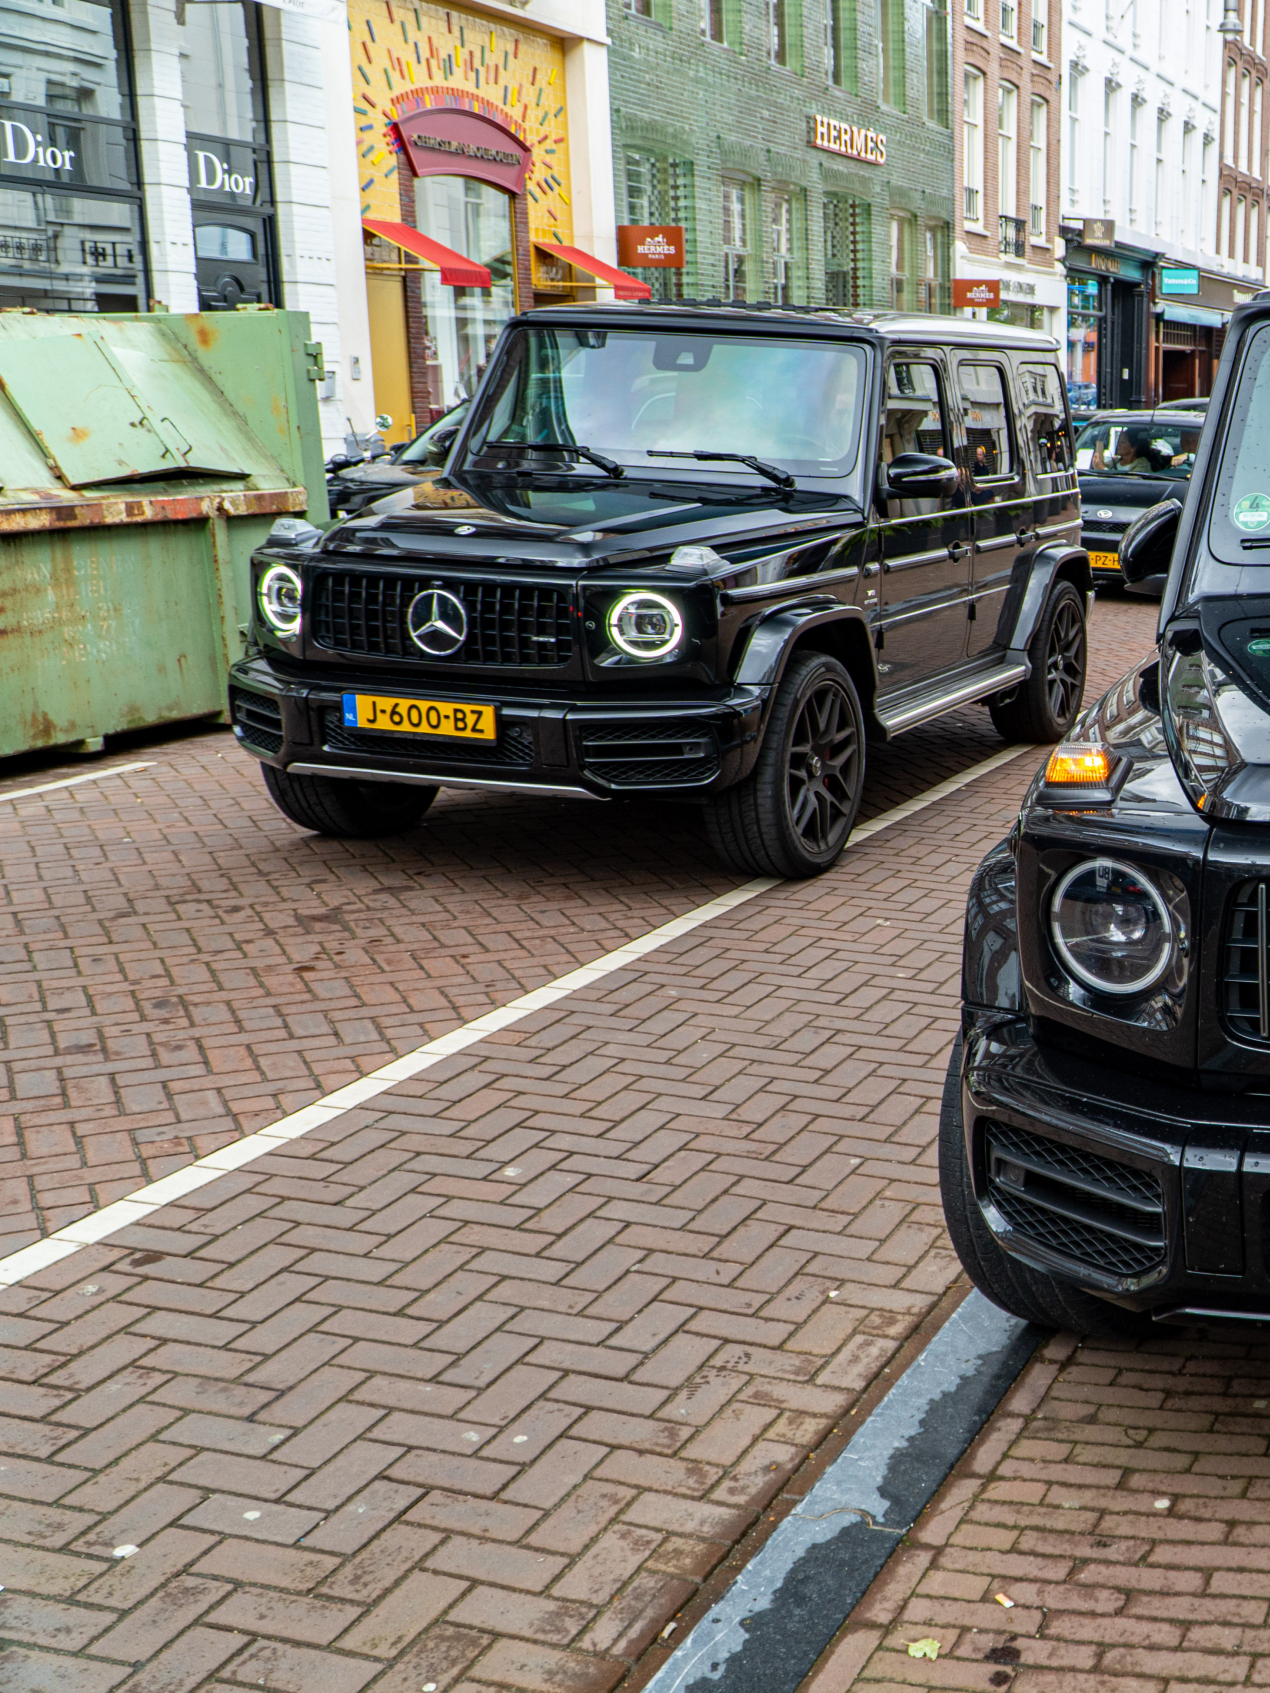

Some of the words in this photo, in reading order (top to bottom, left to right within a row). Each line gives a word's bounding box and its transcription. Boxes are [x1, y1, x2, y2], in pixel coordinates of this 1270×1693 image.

[0, 120, 76, 171] Dior
[194, 150, 254, 195] Dior
[1249, 496, 1260, 512] 4
[366, 701, 485, 734] J-600-BZ
